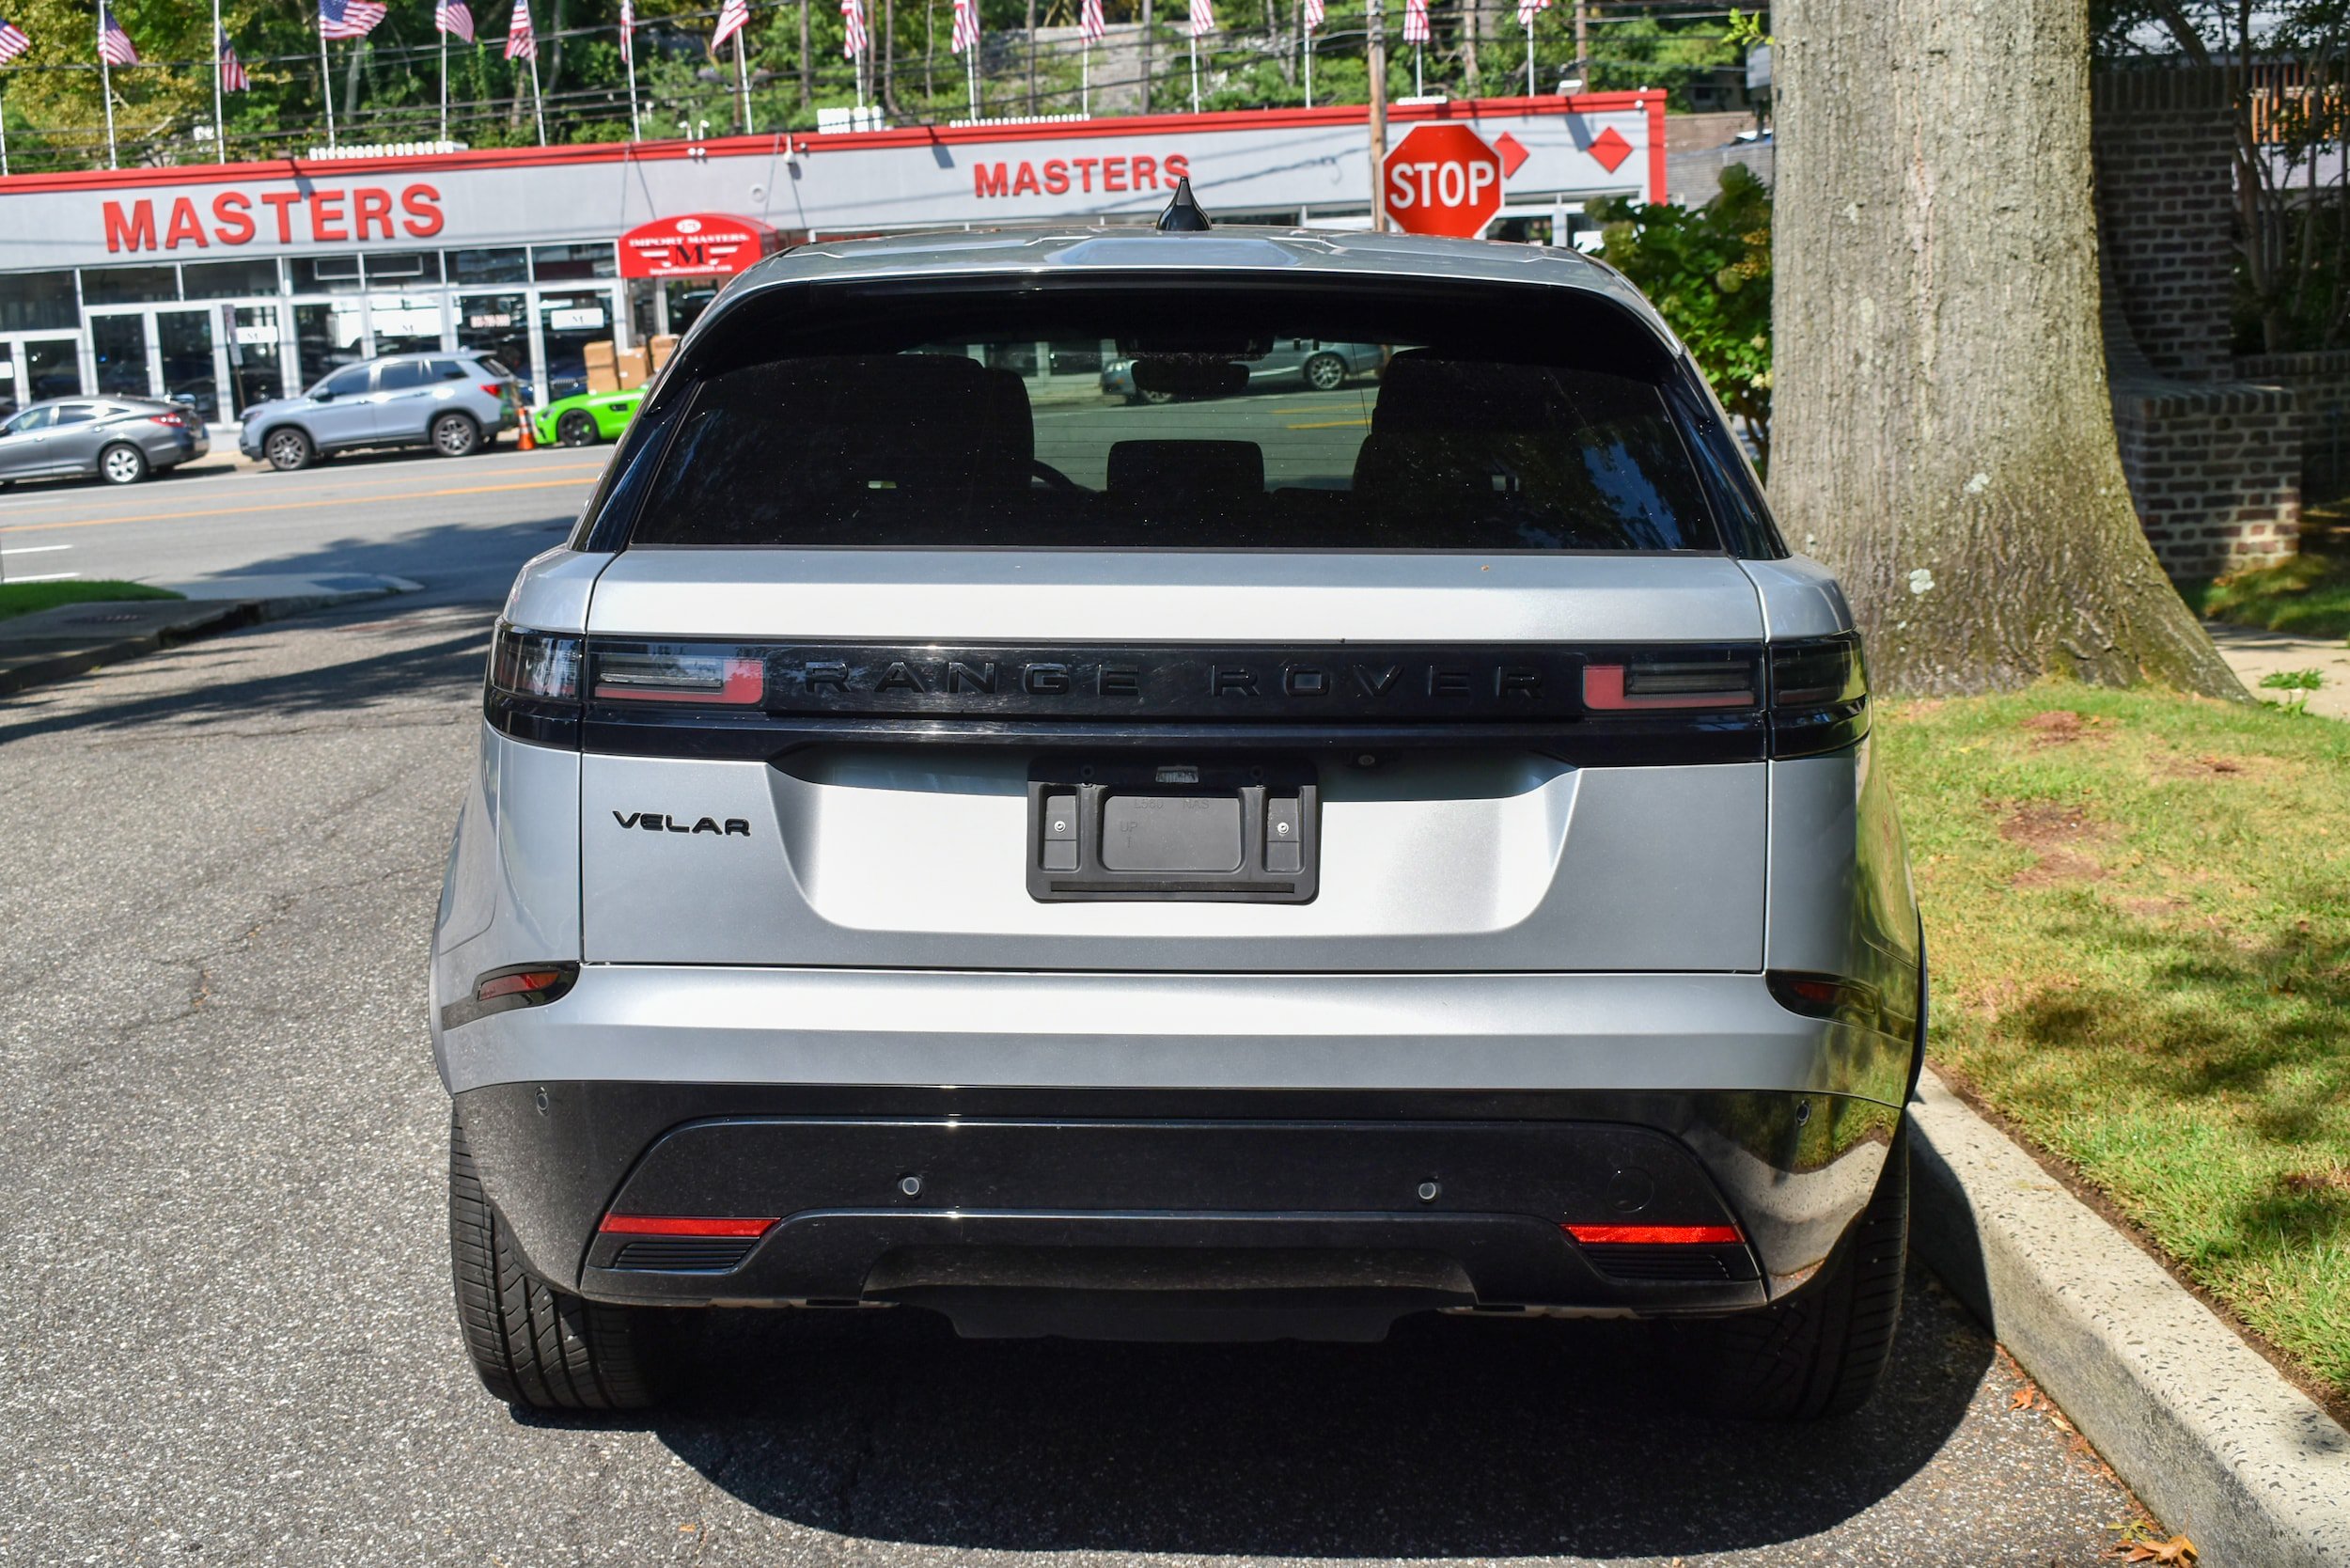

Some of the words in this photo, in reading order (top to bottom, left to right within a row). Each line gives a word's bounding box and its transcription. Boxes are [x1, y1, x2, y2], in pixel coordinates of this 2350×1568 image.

[974, 154, 1190, 198] MASTERS
[1389, 161, 1496, 209] STOP
[102, 183, 445, 252] MASTERS
[629, 236, 683, 247] IMPORT
[674, 243, 705, 265] M
[805, 661, 1140, 697] RANGE
[1211, 663, 1545, 699] ROVER
[612, 810, 751, 838] VELAR
